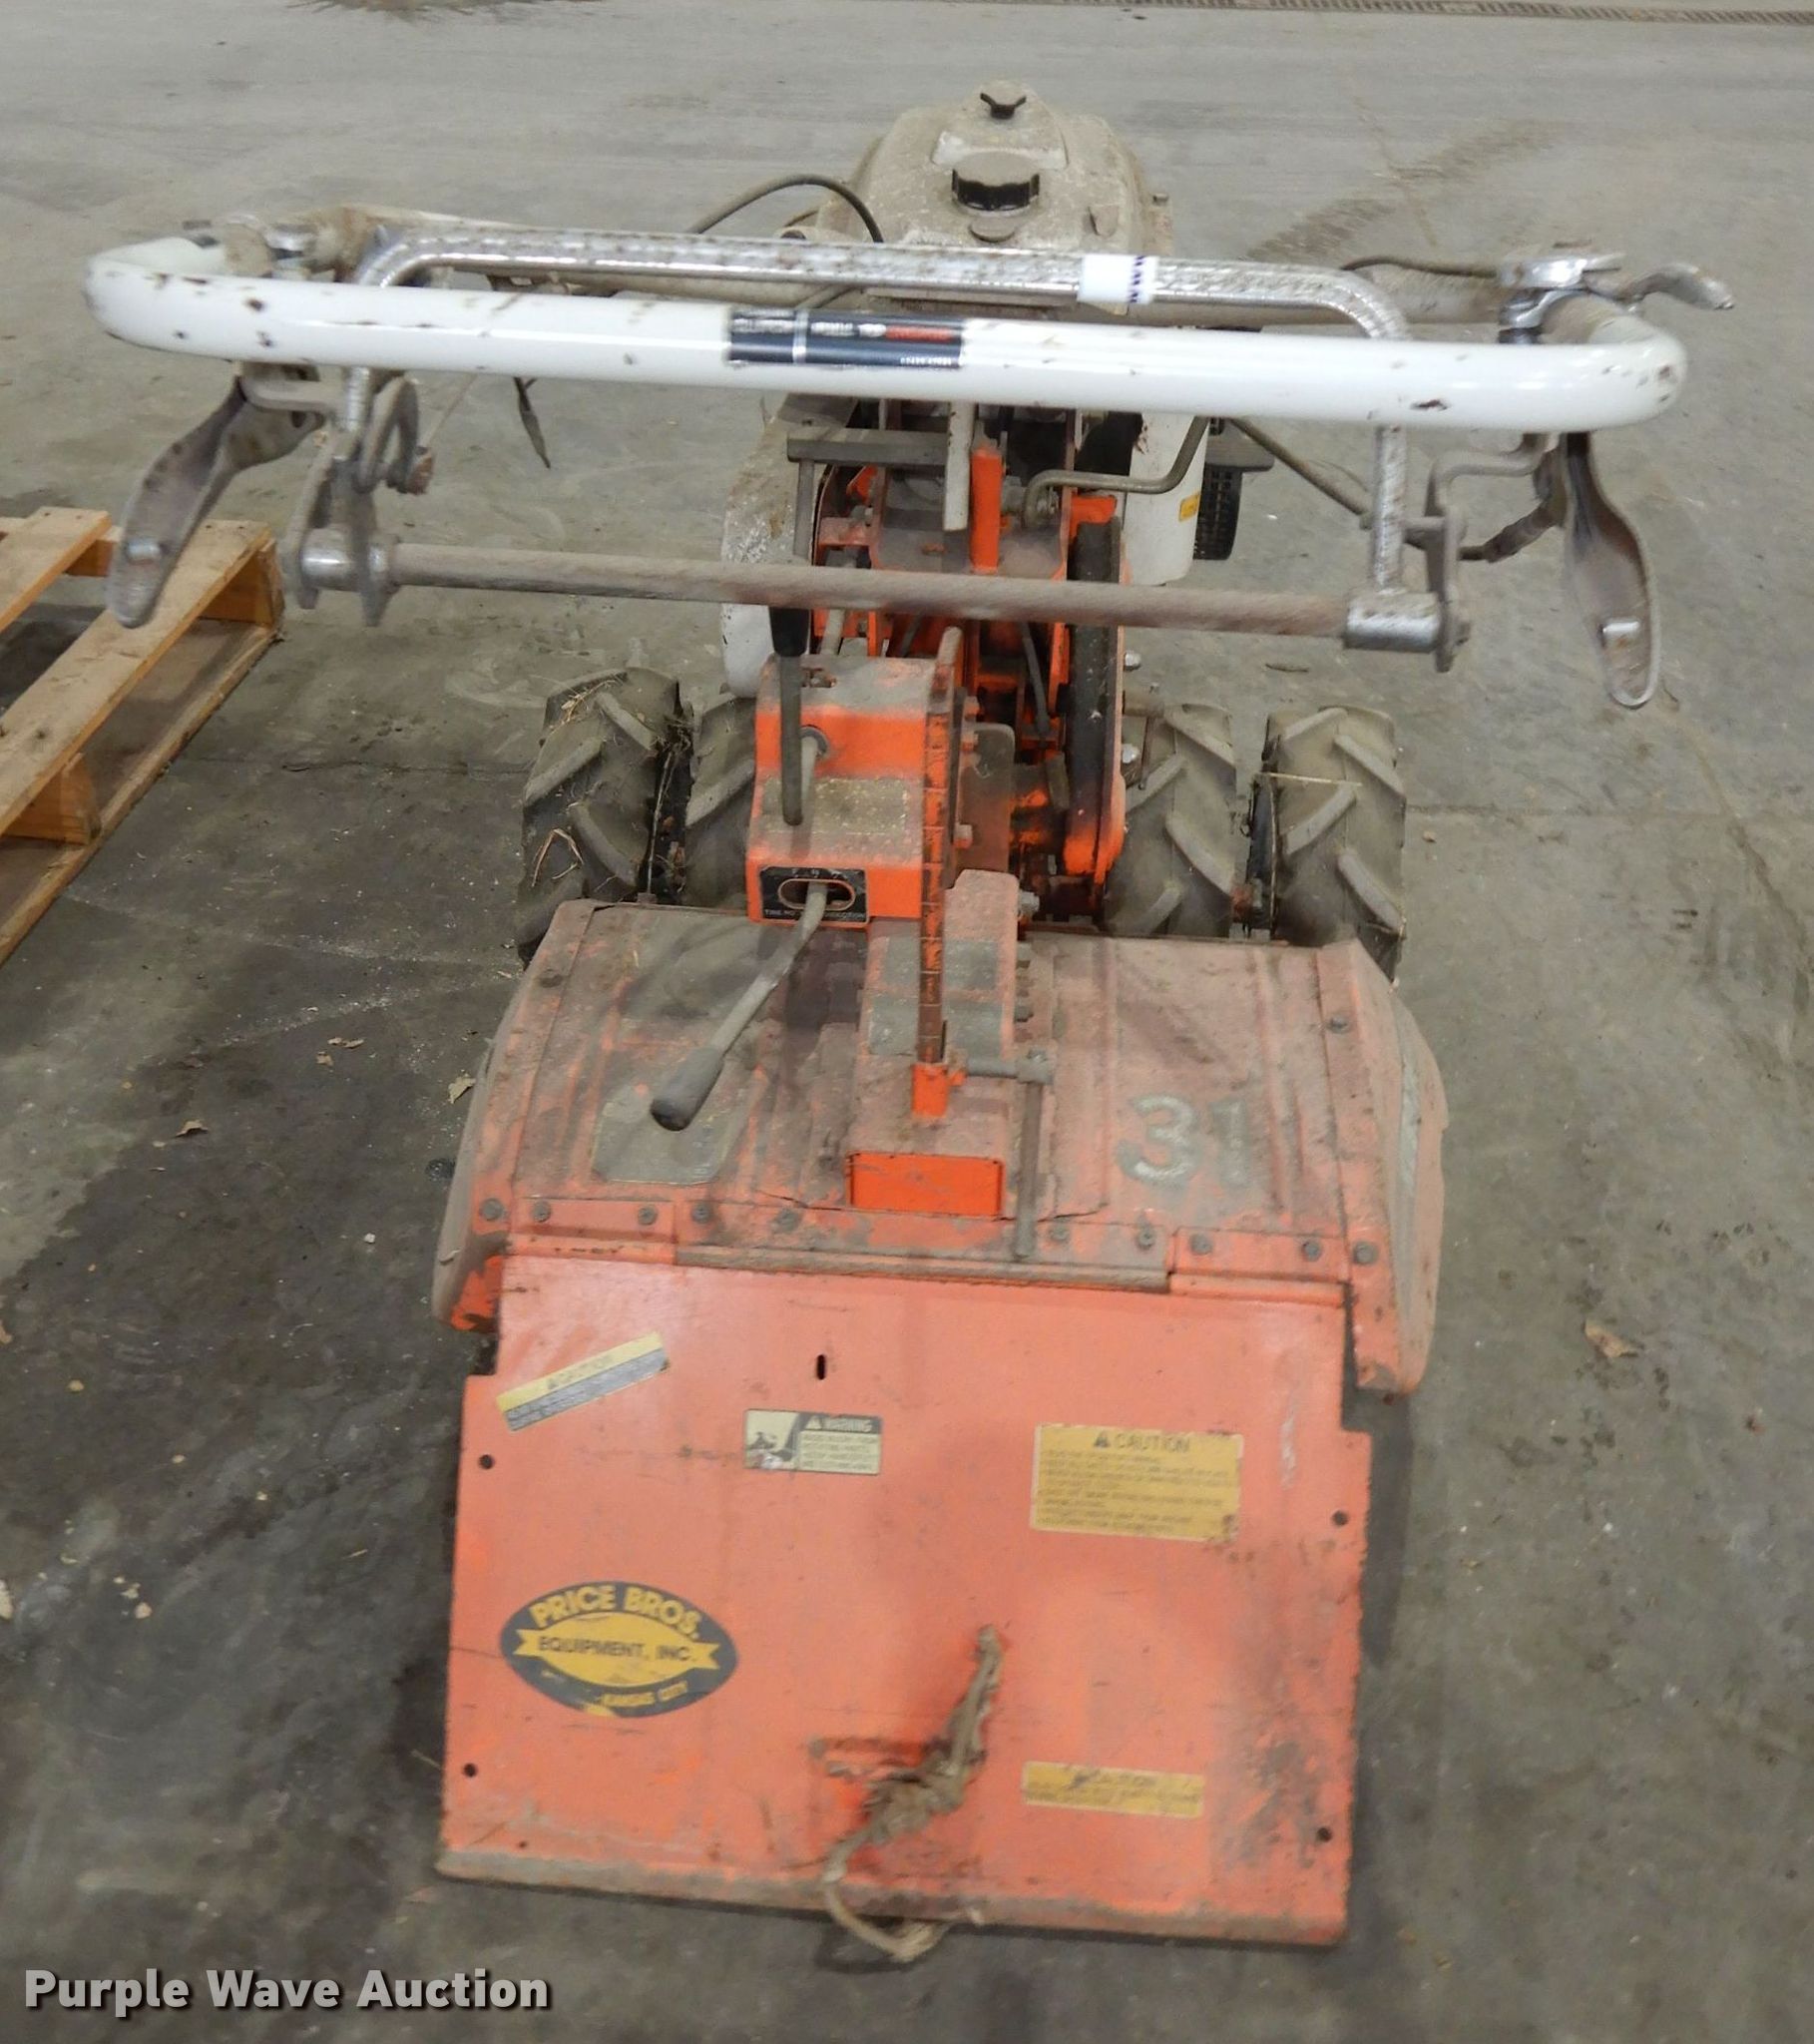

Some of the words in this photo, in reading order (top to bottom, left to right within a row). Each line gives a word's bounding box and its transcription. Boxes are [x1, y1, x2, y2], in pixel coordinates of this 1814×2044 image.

[1116, 1094, 1252, 1188] 31
[1114, 1432, 1190, 1453] CAUTION
[529, 1584, 617, 1627] PRICE
[623, 1586, 703, 1640] BROS.
[538, 1635, 651, 1661] EQUIPMENT,
[656, 1644, 698, 1663] INC.
